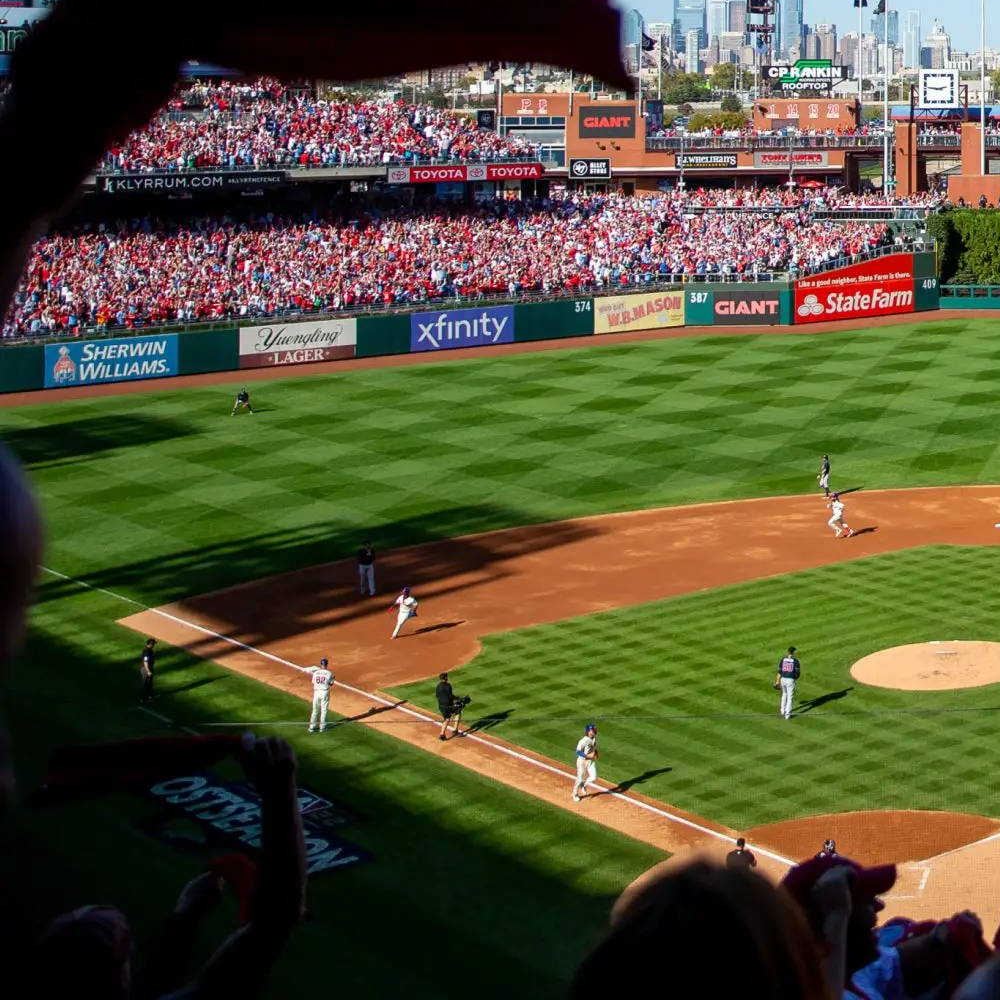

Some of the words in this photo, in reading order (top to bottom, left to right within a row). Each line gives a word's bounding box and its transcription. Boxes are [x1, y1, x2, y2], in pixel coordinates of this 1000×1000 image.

[768, 67, 788, 78] CP
[790, 67, 842, 78] RANKIN
[787, 104, 798, 114] 14
[827, 104, 839, 114] 20
[583, 117, 631, 128] GIANT
[412, 169, 464, 179] TOYOTA
[490, 167, 538, 177] TOYOTA
[117, 176, 223, 190] KLYRRUM.COM
[798, 280, 810, 288] Like
[816, 279, 831, 288] good
[922, 278, 937, 289] 409
[690, 292, 708, 303] 387
[575, 301, 591, 313] 374
[714, 300, 779, 315] GIANT
[418, 312, 508, 348] xfinity
[255, 323, 343, 351] Yuengling
[81, 341, 167, 361] SHERWIN
[274, 349, 324, 364] LAGER
